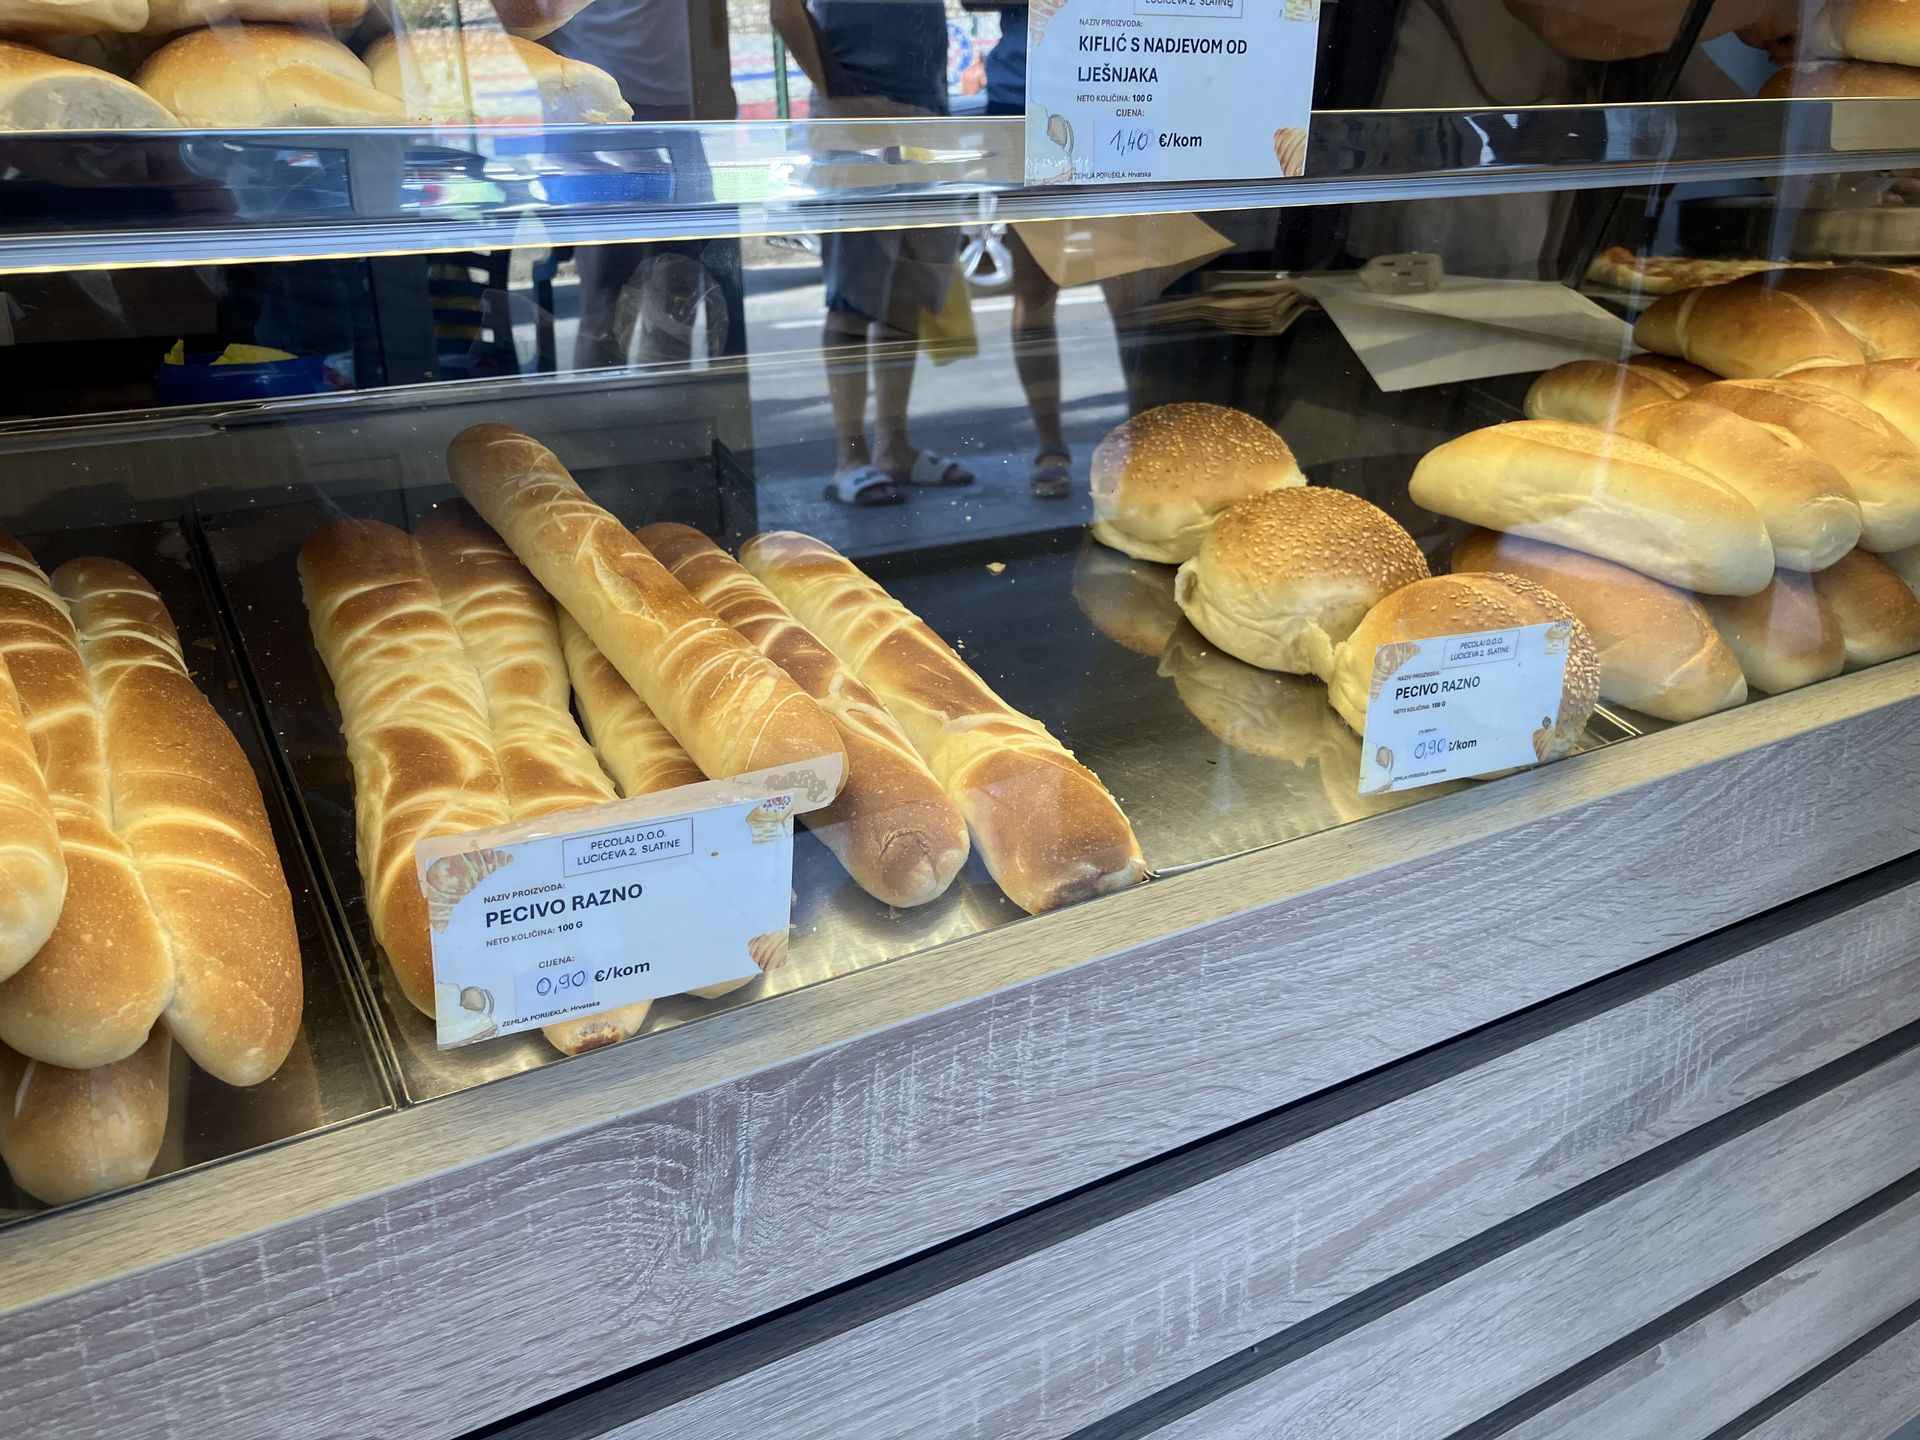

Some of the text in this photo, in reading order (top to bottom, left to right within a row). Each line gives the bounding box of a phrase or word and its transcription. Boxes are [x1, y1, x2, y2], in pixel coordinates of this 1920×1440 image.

[1079, 18, 1143, 27] NAZIV PROIZVODA:
[1079, 33, 1248, 54] KIFLIĆ S NADJEVOM OD
[1077, 63, 1159, 83] LJEŠNJAKA
[1076, 94, 1095, 102] NETO
[1132, 94, 1145, 102] 100
[1146, 94, 1153, 102] G
[1115, 108, 1145, 117] CIJENA:
[1109, 129, 1203, 156] 1,40 €/kom
[1395, 676, 1481, 700] PECIVO RAZNO
[1414, 738, 1447, 759] 0,90
[591, 834, 635, 850] PECOLAJ
[642, 839, 681, 853] SLATINE
[484, 883, 566, 904] NAZIV PROIZVODA:
[486, 883, 643, 928] PECIVO RAZNO
[486, 936, 510, 947] NETO
[557, 922, 574, 933] 100
[576, 921, 583, 929] G
[538, 955, 575, 969] CIJENA:
[536, 961, 650, 996] 0,90 €/kom
[502, 1016, 529, 1028] ZEMLJA
[570, 1001, 601, 1012] Hrvatska
